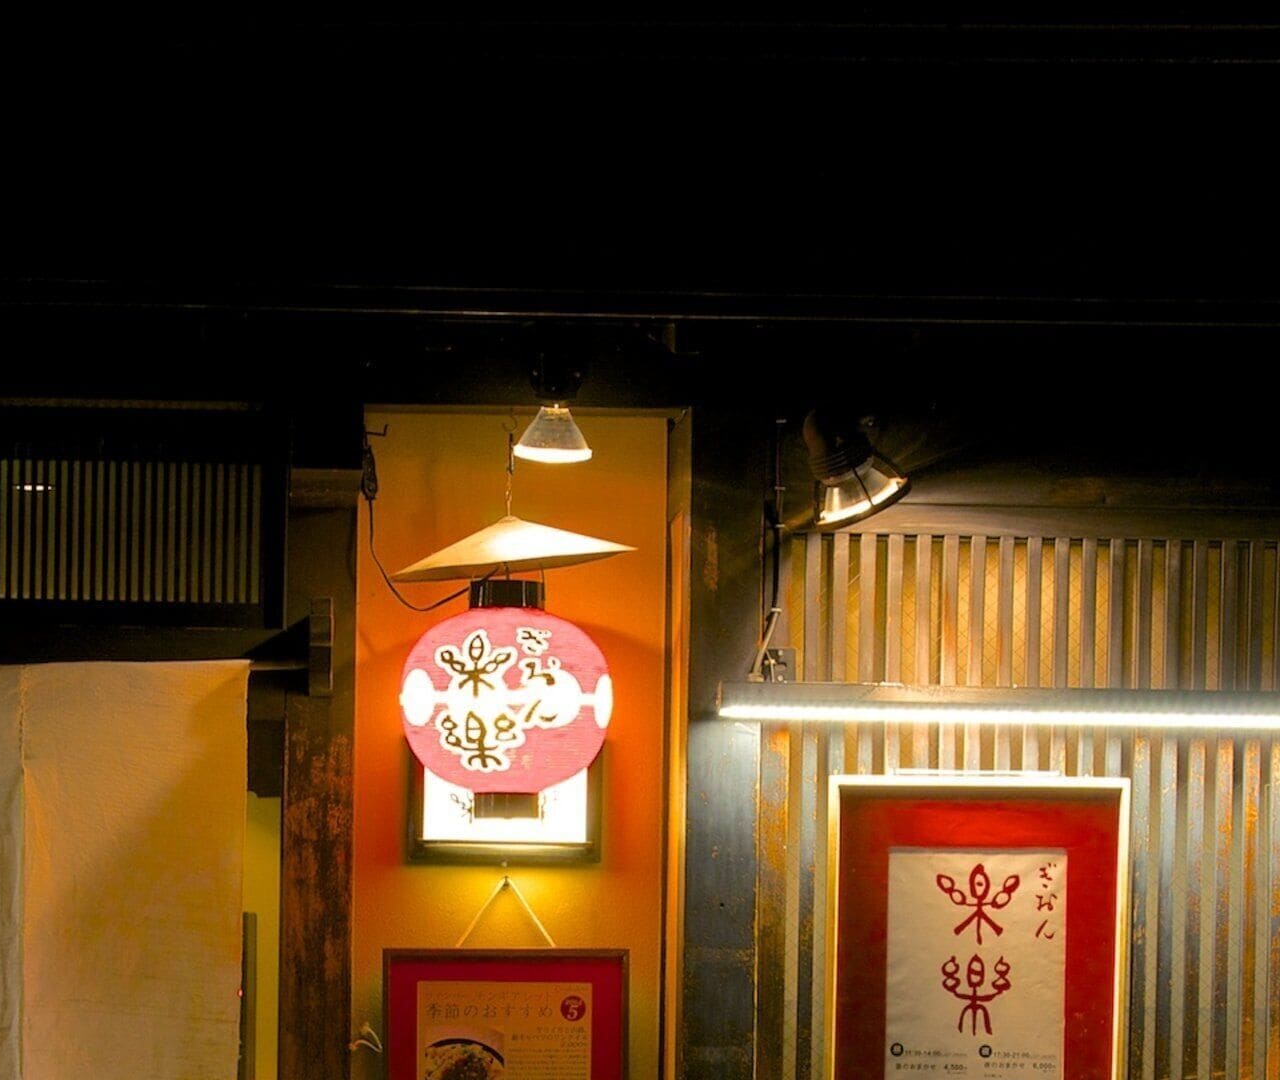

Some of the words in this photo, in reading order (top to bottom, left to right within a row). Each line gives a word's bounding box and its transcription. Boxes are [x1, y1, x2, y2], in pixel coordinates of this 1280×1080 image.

[1034, 861, 1058, 940] ぎおん
[426, 1003, 554, 1019] 季節のおすすめ
[567, 1004, 579, 1020] 5
